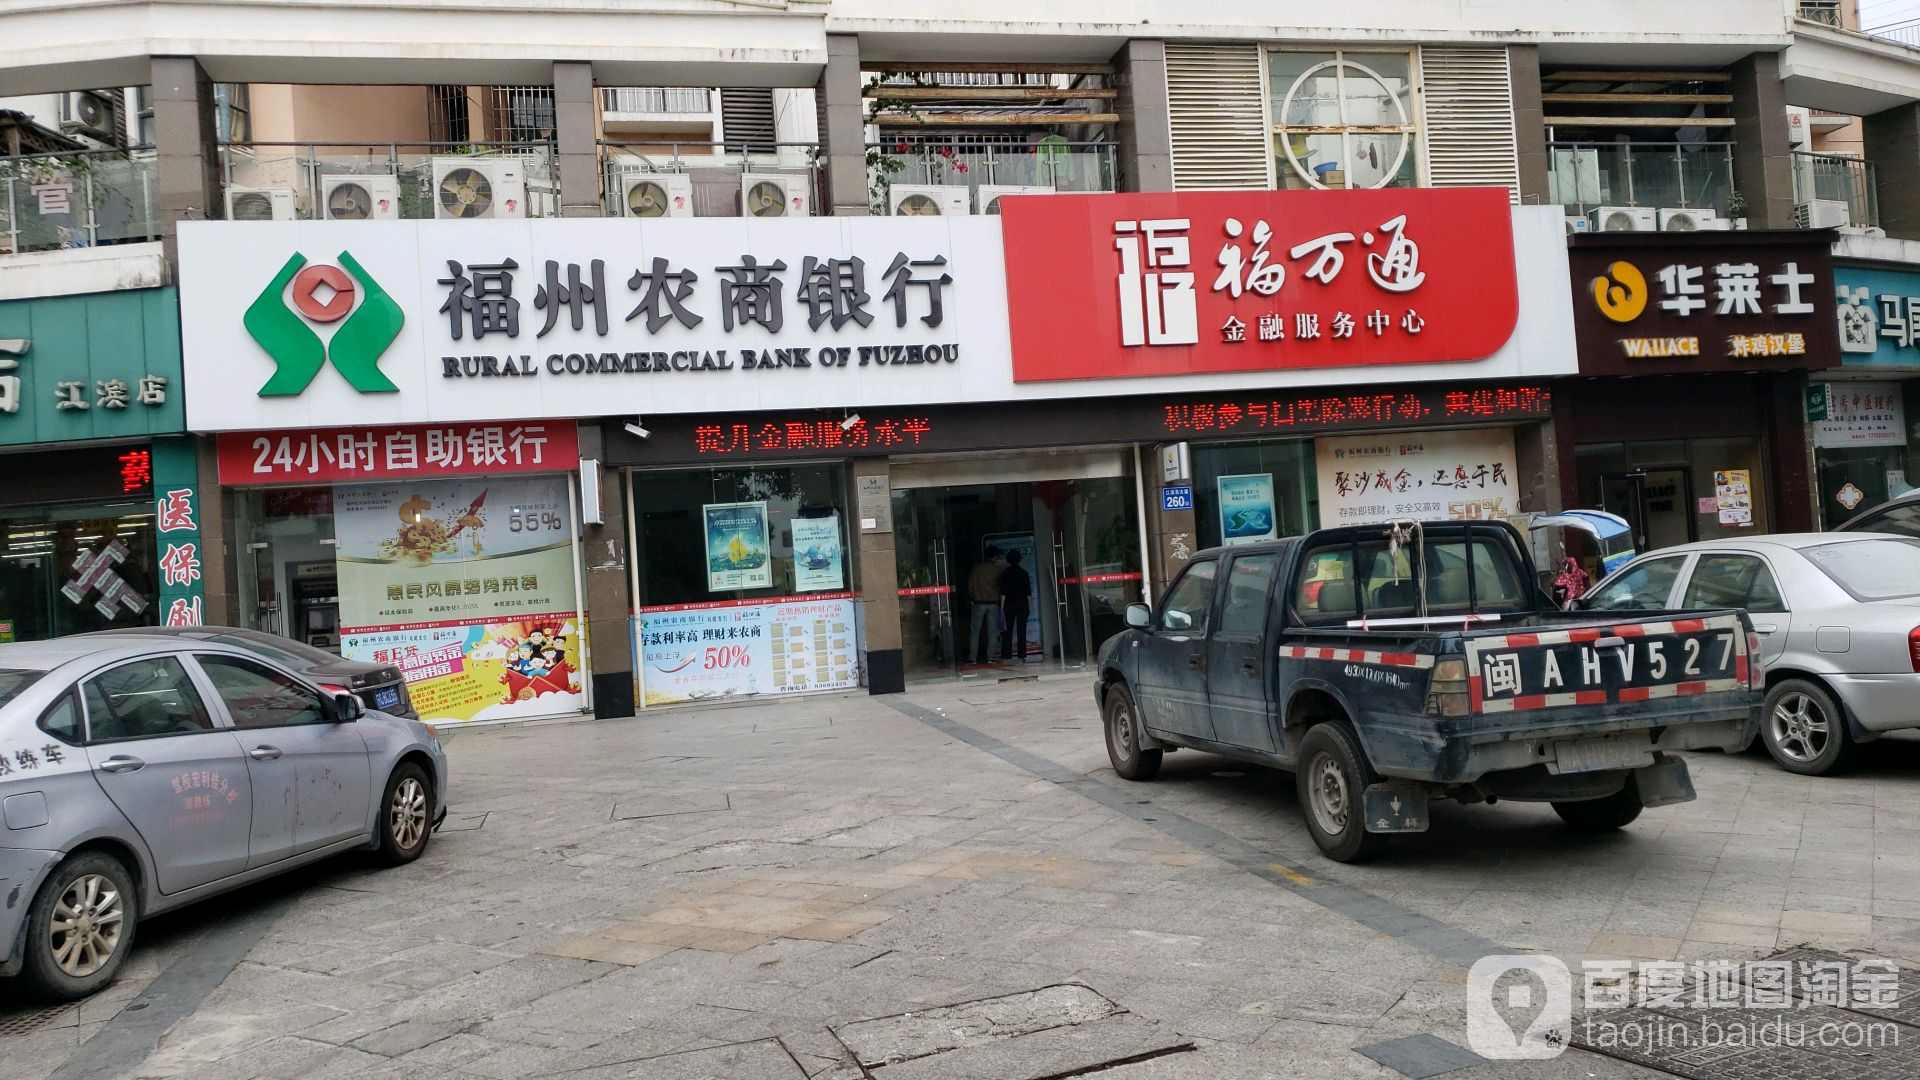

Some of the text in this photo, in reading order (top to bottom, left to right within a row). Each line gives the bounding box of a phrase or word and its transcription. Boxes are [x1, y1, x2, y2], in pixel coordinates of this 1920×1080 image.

[1213, 214, 1425, 299] 福万通
[437, 251, 954, 340] 福州农商银行
[1656, 262, 1815, 317] 华莱士
[1221, 308, 1426, 343] 金融服务中心
[1621, 336, 1699, 358] WALLACE
[1732, 333, 1806, 358] 炸鸡汉堡
[442, 343, 960, 378] RURAL COMMERCIAL BANK OF FUZHOU
[54, 374, 169, 411] 江滨店
[252, 426, 548, 474] 24小时自助银行
[1167, 496, 1185, 507] 260
[509, 511, 562, 533] 55%
[387, 575, 538, 601] 惠民风暴强势来袭
[702, 625, 761, 641] 理财来农商
[703, 643, 752, 670] 50%
[1375, 816, 1420, 829] 金杯
